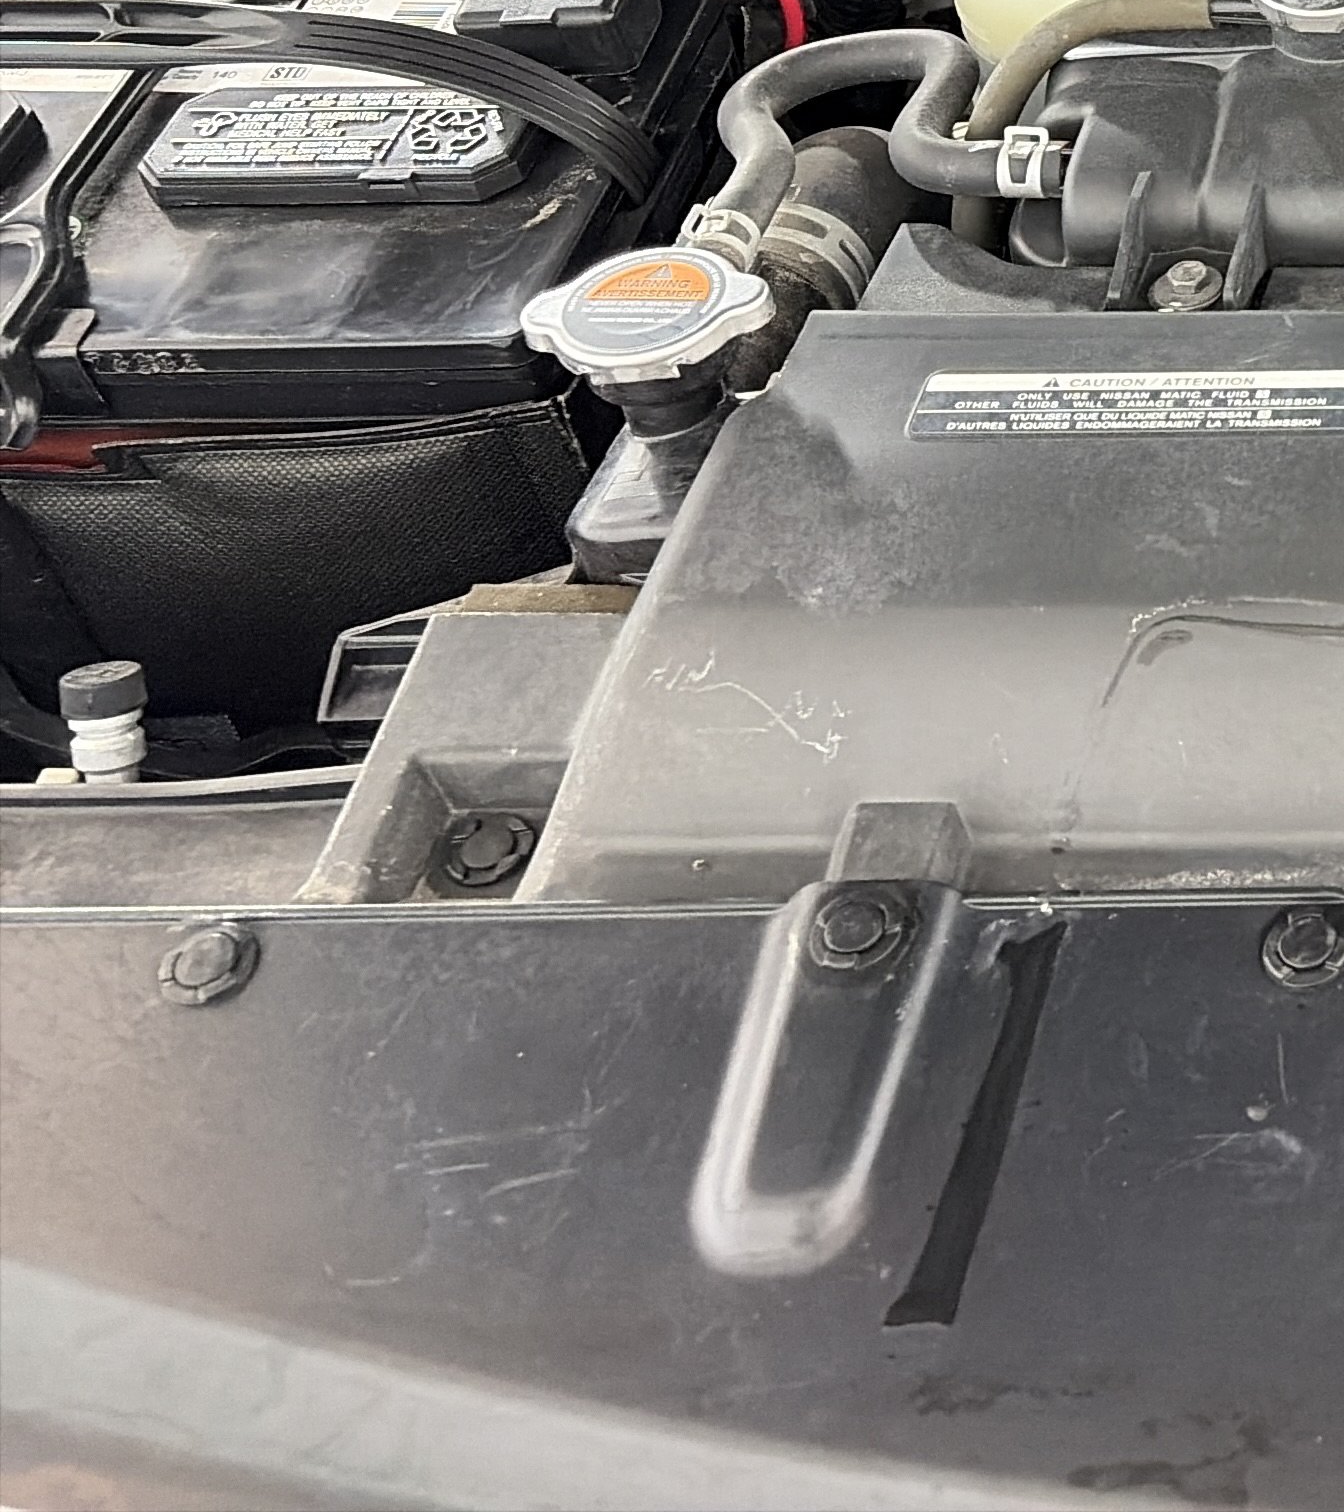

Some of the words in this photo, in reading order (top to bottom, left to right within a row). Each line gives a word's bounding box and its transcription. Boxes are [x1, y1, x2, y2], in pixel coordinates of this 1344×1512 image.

[213, 71, 238, 79] 140
[269, 66, 309, 79] STD
[238, 113, 279, 122] FLUSH
[278, 113, 310, 121] EYES
[311, 112, 391, 121] IMMEDIATELY
[233, 121, 266, 130] WITH
[311, 120, 338, 129] GET
[228, 129, 277, 138] MEDICAL
[279, 129, 313, 137] HELP
[312, 127, 347, 137] FAST
[617, 279, 692, 288] WARNING
[592, 289, 704, 297] AVERTISSEMENT
[1069, 378, 1147, 387] CAUTION
[1161, 377, 1256, 387] ATTENTION
[1017, 392, 1053, 401] ONLY
[1062, 392, 1090, 400] USE
[1100, 391, 1151, 400] NISSAN
[1160, 391, 1201, 399] MATIC
[1211, 390, 1250, 399] FLUID
[954, 401, 1000, 409] OTHER
[1012, 400, 1060, 409] FLUIDS
[1072, 400, 1104, 409] WILL
[1116, 399, 1174, 408] DAMAGE
[1187, 398, 1213, 407] THE
[1226, 397, 1327, 406] TRANSMISSION
[1073, 412, 1100, 421] QUE
[1101, 412, 1120, 420] DU
[1121, 412, 1167, 420] LIQUIDE
[1169, 411, 1205, 419] MATIC
[1206, 411, 1252, 419] NISSAN
[946, 422, 1007, 431] D'AUTRES
[1011, 421, 1070, 430] LIQUIDES
[1075, 420, 1201, 430] ENDOMMAGERAIENT
[1205, 420, 1223, 428] LA
[1228, 419, 1321, 428] TRANSMISSION
